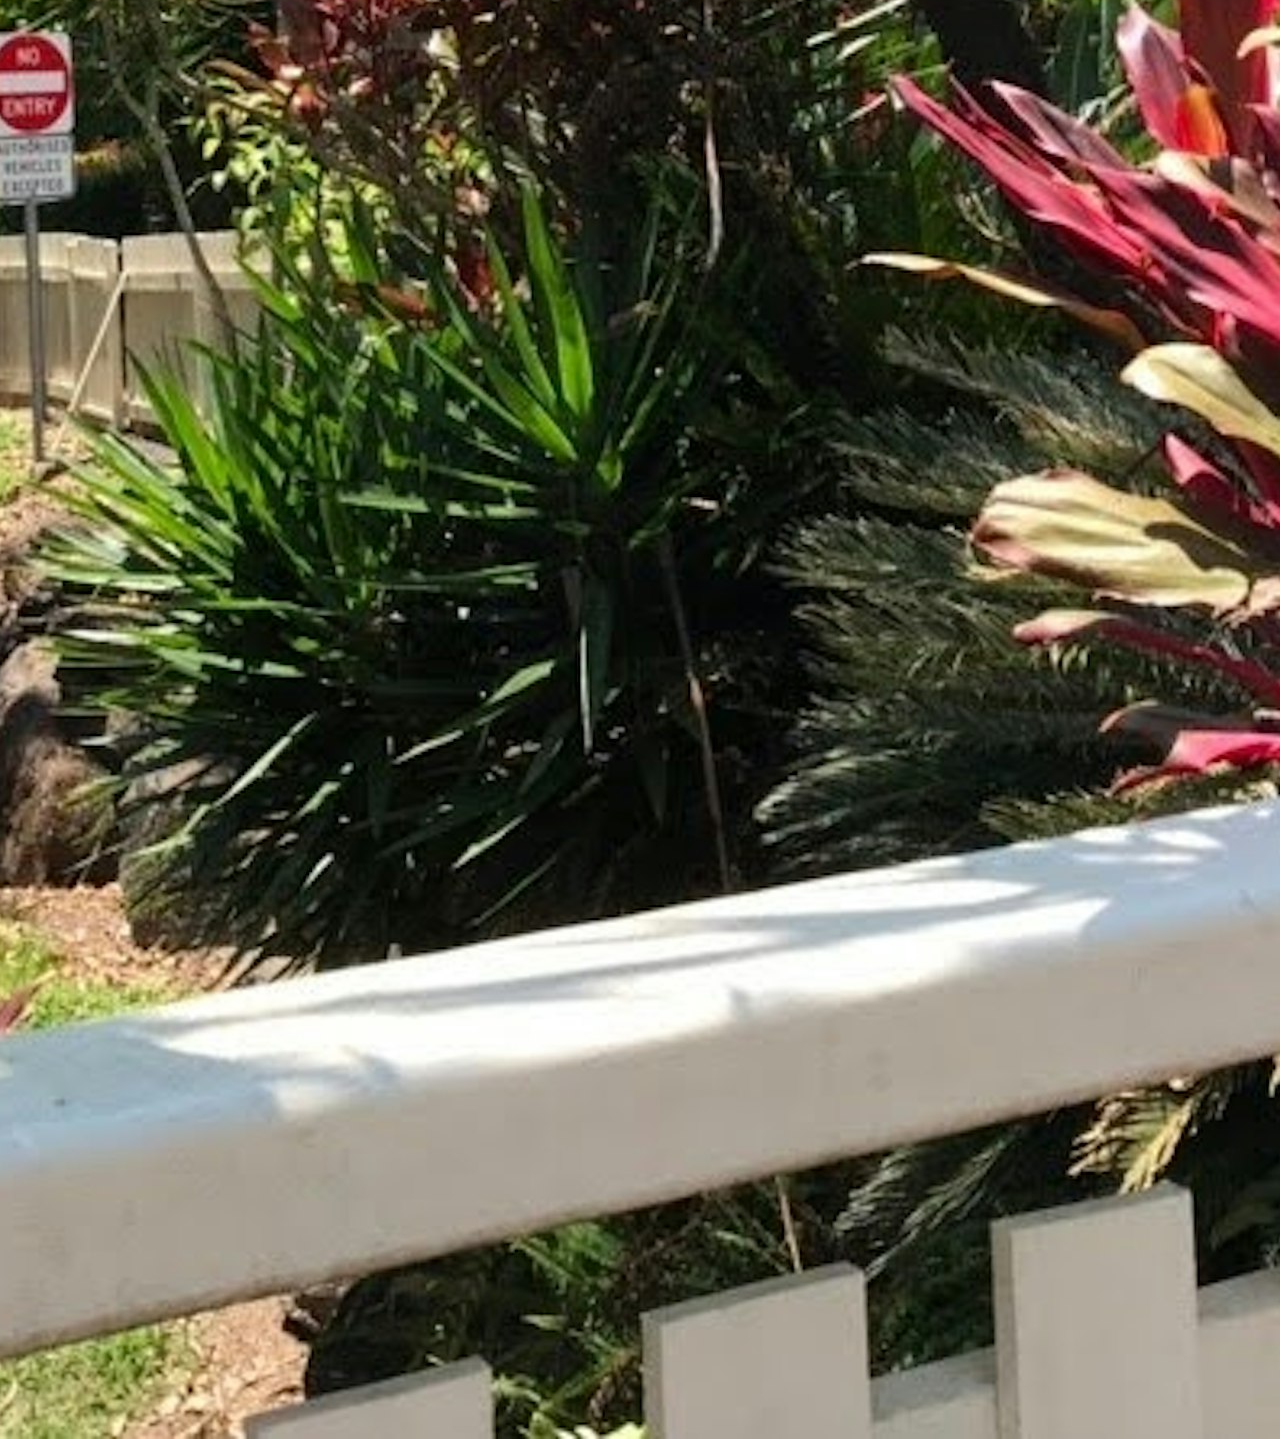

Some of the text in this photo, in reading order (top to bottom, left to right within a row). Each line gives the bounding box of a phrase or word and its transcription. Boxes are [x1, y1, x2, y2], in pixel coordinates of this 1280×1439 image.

[15, 45, 41, 67] NO
[2, 96, 58, 118] ENTRY
[4, 159, 62, 176] VEHICLES
[3, 178, 64, 194] EXCEPTED
